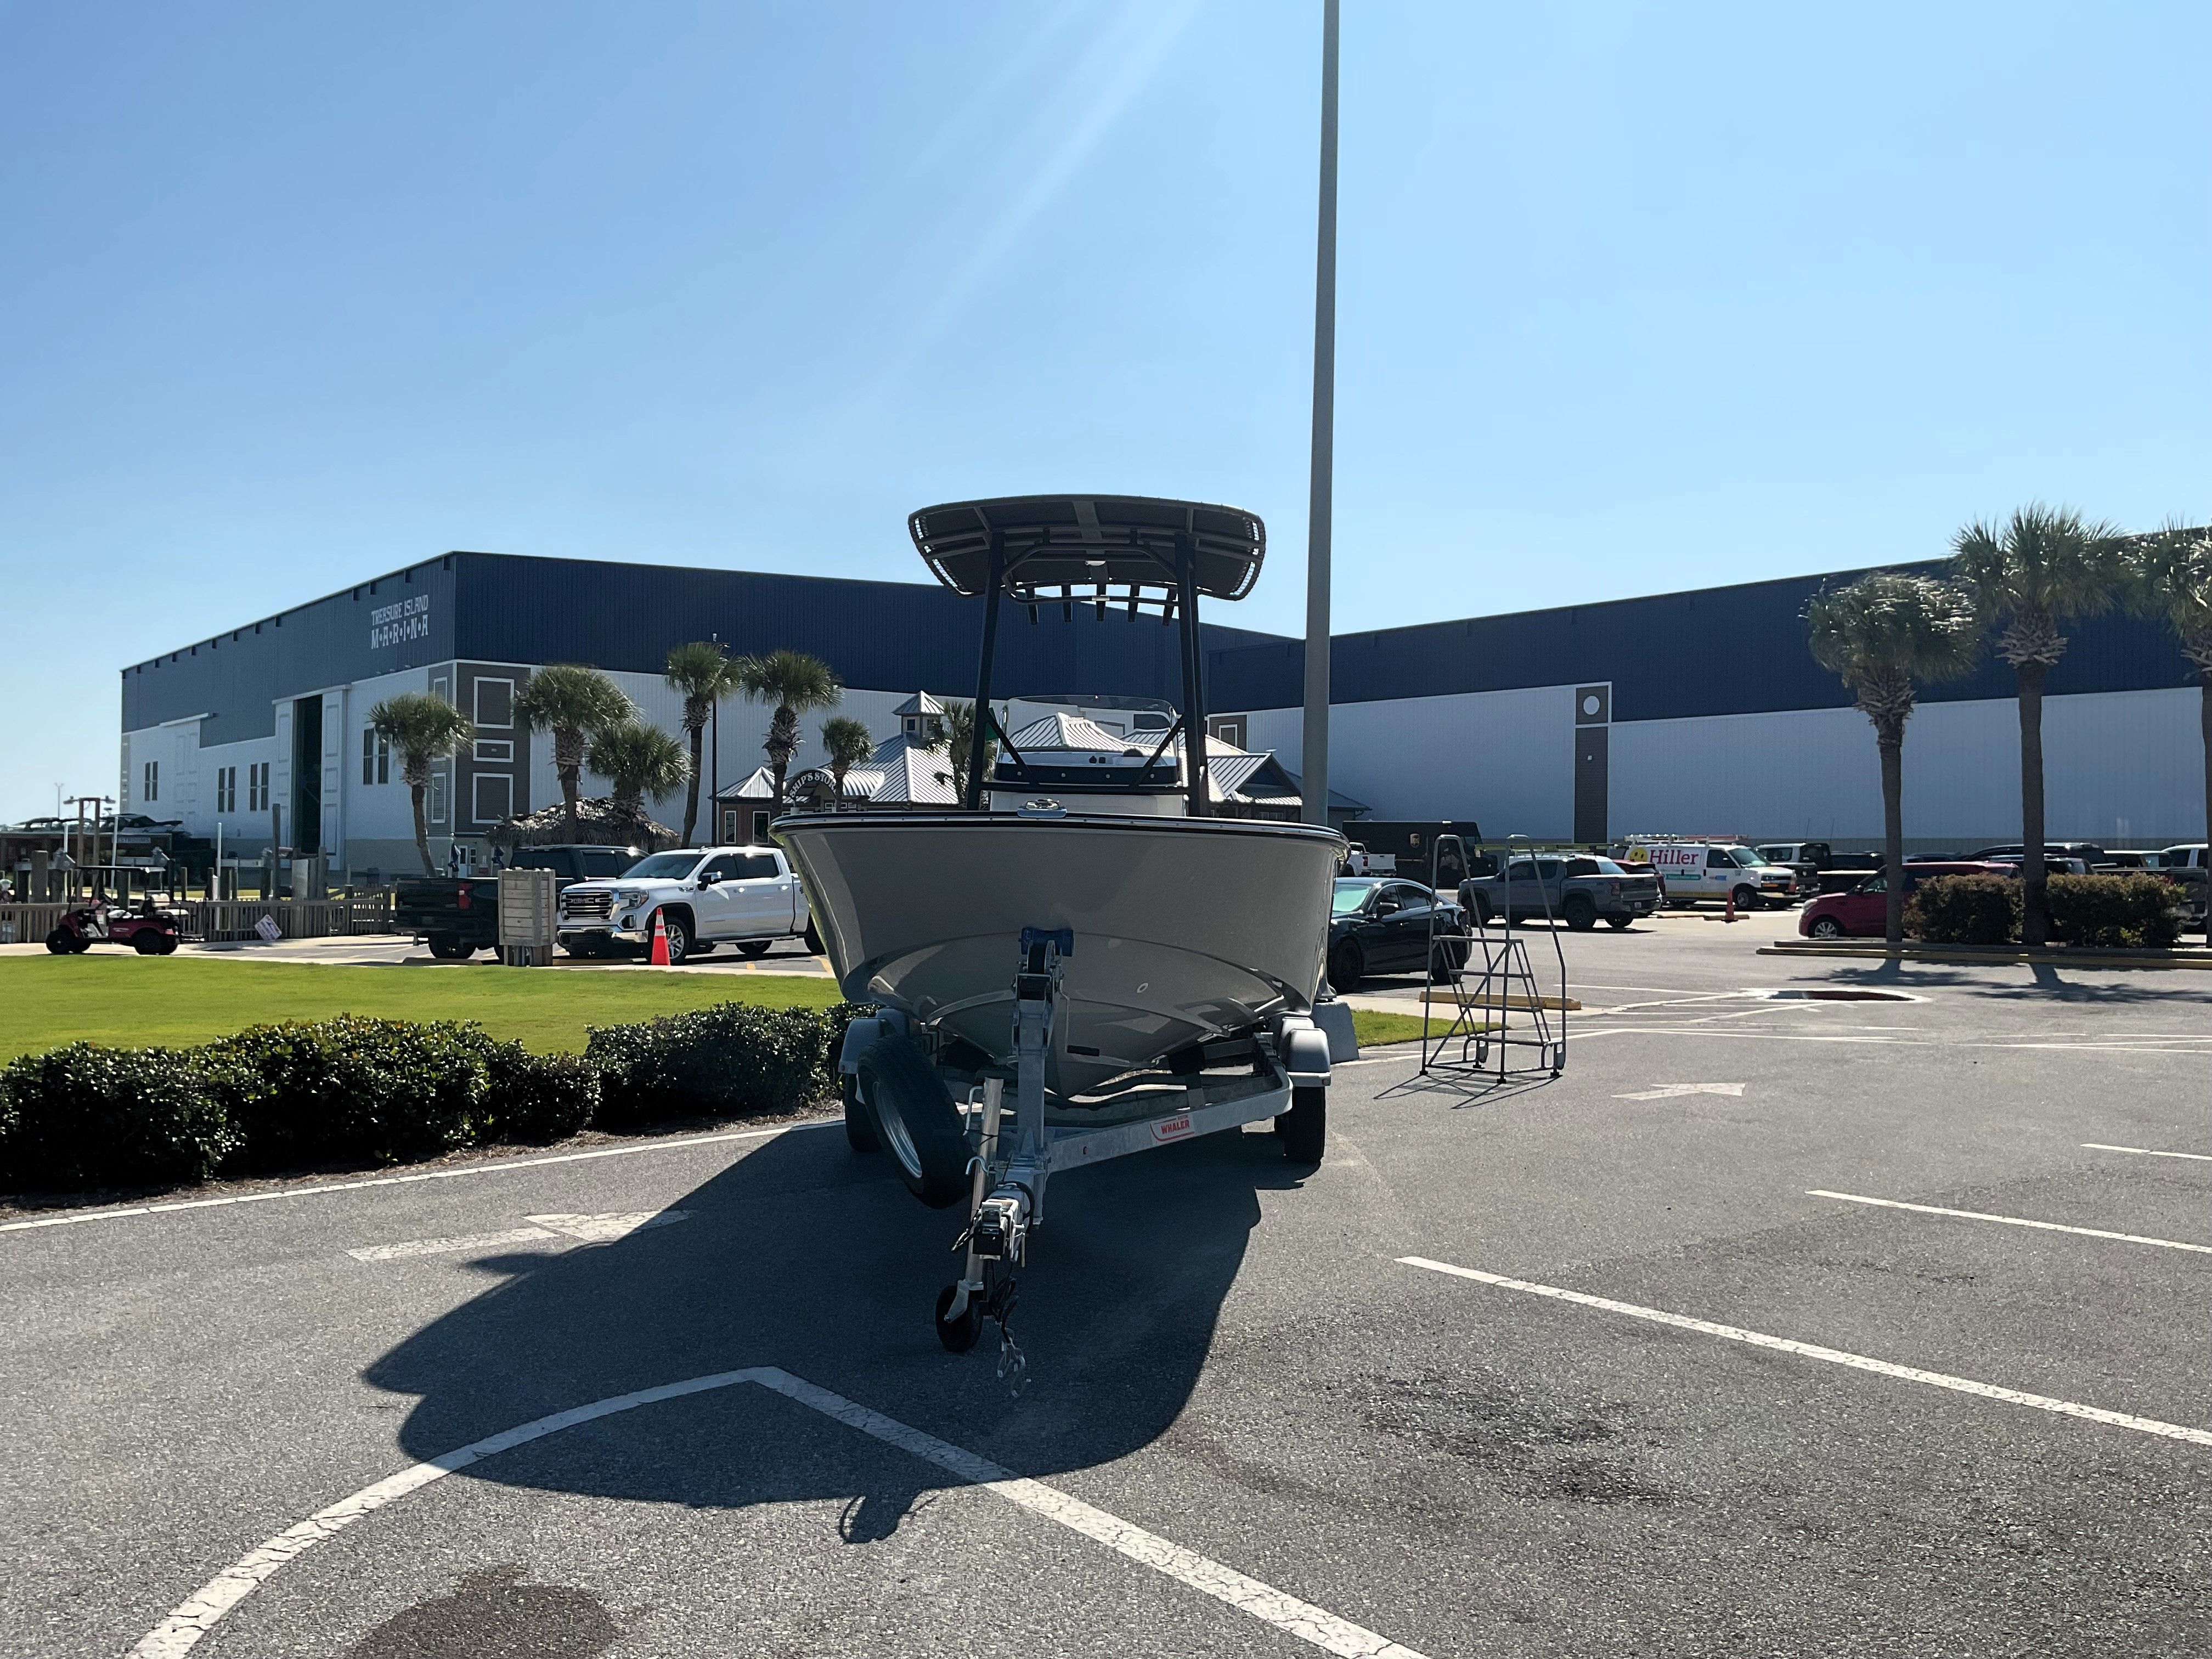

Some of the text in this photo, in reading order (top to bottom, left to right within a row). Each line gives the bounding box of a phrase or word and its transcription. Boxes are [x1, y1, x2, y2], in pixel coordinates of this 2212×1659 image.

[371, 594, 428, 626] TREASURE ISLAND
[789, 772, 813, 798] SHIP'S
[1650, 850, 1699, 865] Hiller
[1161, 1120, 1189, 1134] WHALER
